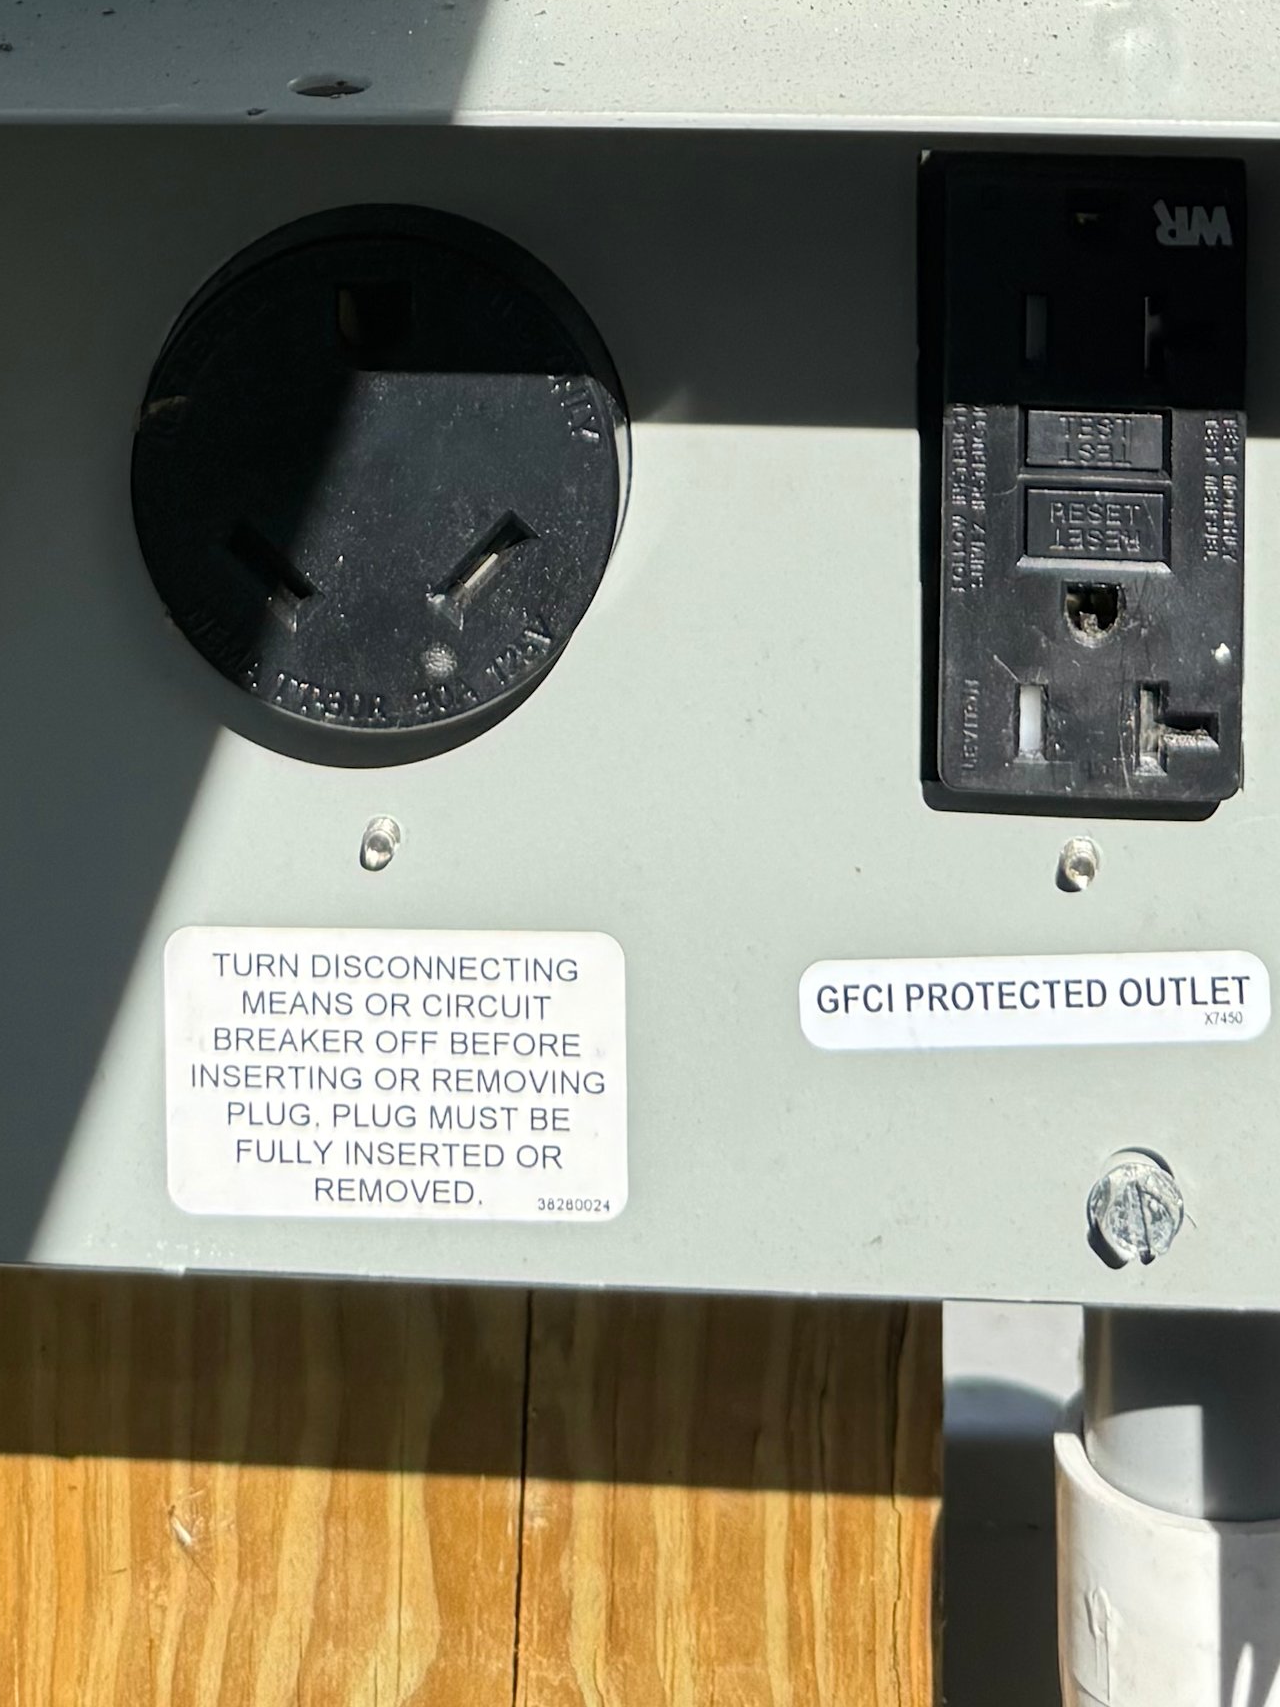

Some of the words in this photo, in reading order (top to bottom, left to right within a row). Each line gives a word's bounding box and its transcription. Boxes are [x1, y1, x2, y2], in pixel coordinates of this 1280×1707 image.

[1151, 197, 1235, 249] WR
[1058, 416, 1133, 441] TEST
[1057, 442, 1133, 468] TEST
[1049, 501, 1141, 526] RESET
[1049, 528, 1141, 553] RESET
[212, 952, 298, 977] TURN
[311, 954, 577, 982] DISCONNECTING
[242, 990, 352, 1015] MEANS
[365, 992, 410, 1016] OR
[422, 993, 551, 1020] CIRCUIT
[816, 983, 893, 1013] GFCI
[905, 979, 1106, 1012] PROTECTED
[1119, 975, 1249, 1006] OUTLET
[1204, 1011, 1242, 1024] X7450
[214, 1027, 363, 1053] BREAKER
[375, 1030, 437, 1054] OFF
[450, 1031, 580, 1057] BEFORE
[191, 1063, 361, 1089] INSERTING
[374, 1067, 420, 1091] OR
[432, 1068, 604, 1094] REMOVING
[227, 1101, 319, 1126] PLUG.
[333, 1103, 416, 1128] PLUG
[429, 1105, 518, 1131] MUST
[530, 1107, 569, 1131] BE
[236, 1139, 332, 1164] FULLY
[346, 1140, 504, 1167] INSERTED
[516, 1144, 562, 1169] OR
[314, 1177, 482, 1204] REMOVED.
[537, 1197, 609, 1212] 38280024
